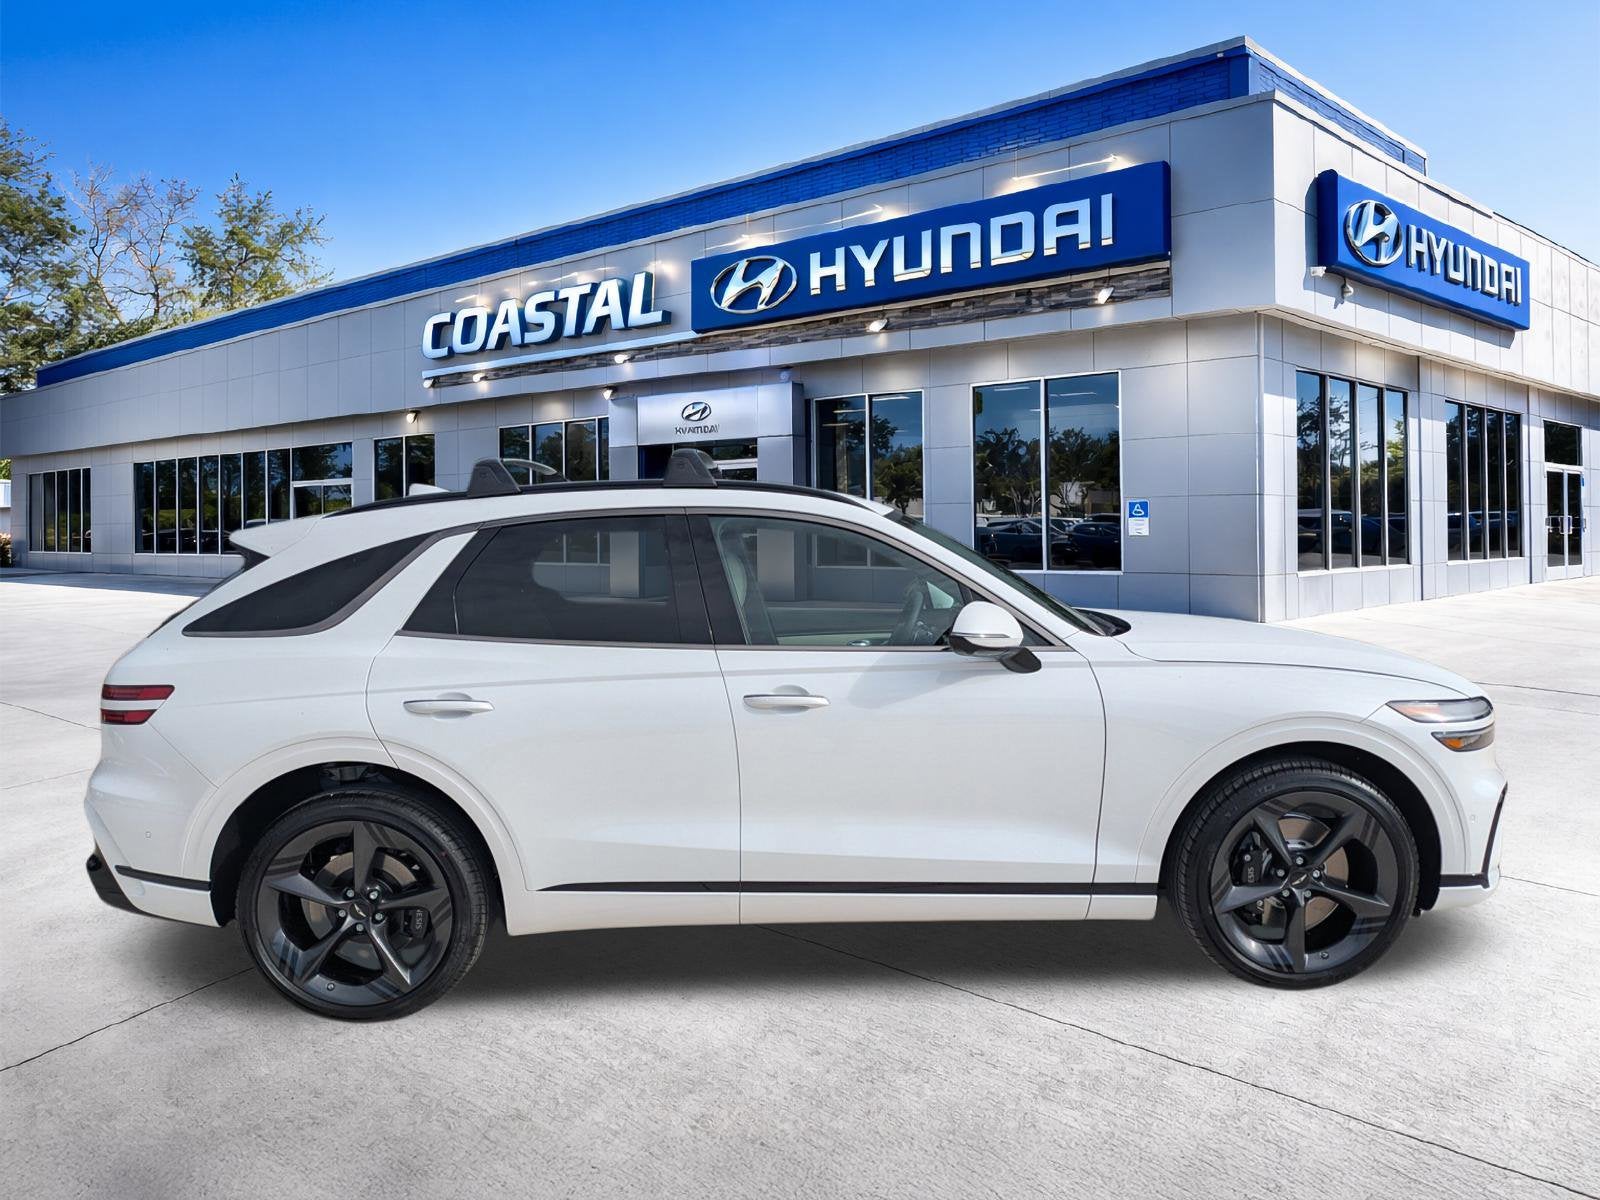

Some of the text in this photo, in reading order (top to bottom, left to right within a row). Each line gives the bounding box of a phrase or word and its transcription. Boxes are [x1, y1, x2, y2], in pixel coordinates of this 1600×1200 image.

[809, 192, 1113, 296] HYUNDAI
[1407, 223, 1522, 306] HYUNDAI
[422, 270, 666, 360] COASTAL
